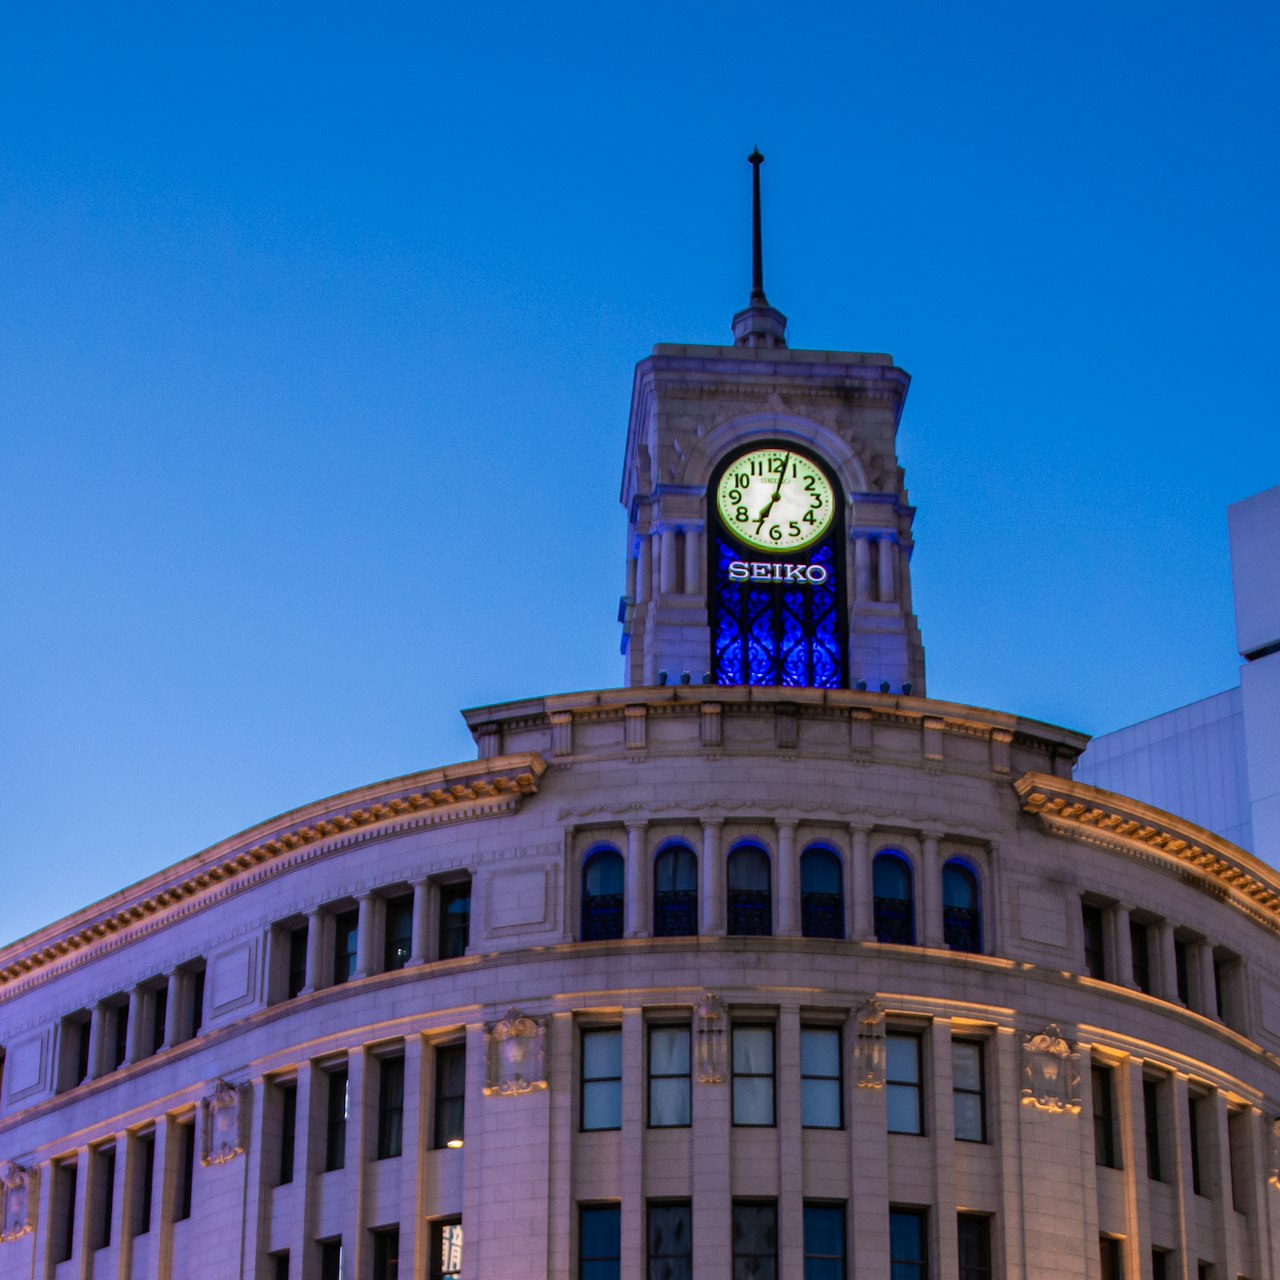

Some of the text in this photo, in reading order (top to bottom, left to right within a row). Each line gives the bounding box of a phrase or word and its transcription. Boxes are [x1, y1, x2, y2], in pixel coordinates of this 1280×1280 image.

[750, 461, 763, 476] 11
[734, 473, 750, 489] 10
[803, 475, 816, 491] 2
[728, 489, 742, 505] 9
[810, 493, 823, 509] 3
[735, 506, 749, 522] 8
[802, 509, 817, 526] 4
[769, 525, 782, 541] 6
[788, 521, 801, 537] 5
[728, 561, 827, 584] SEIKO
